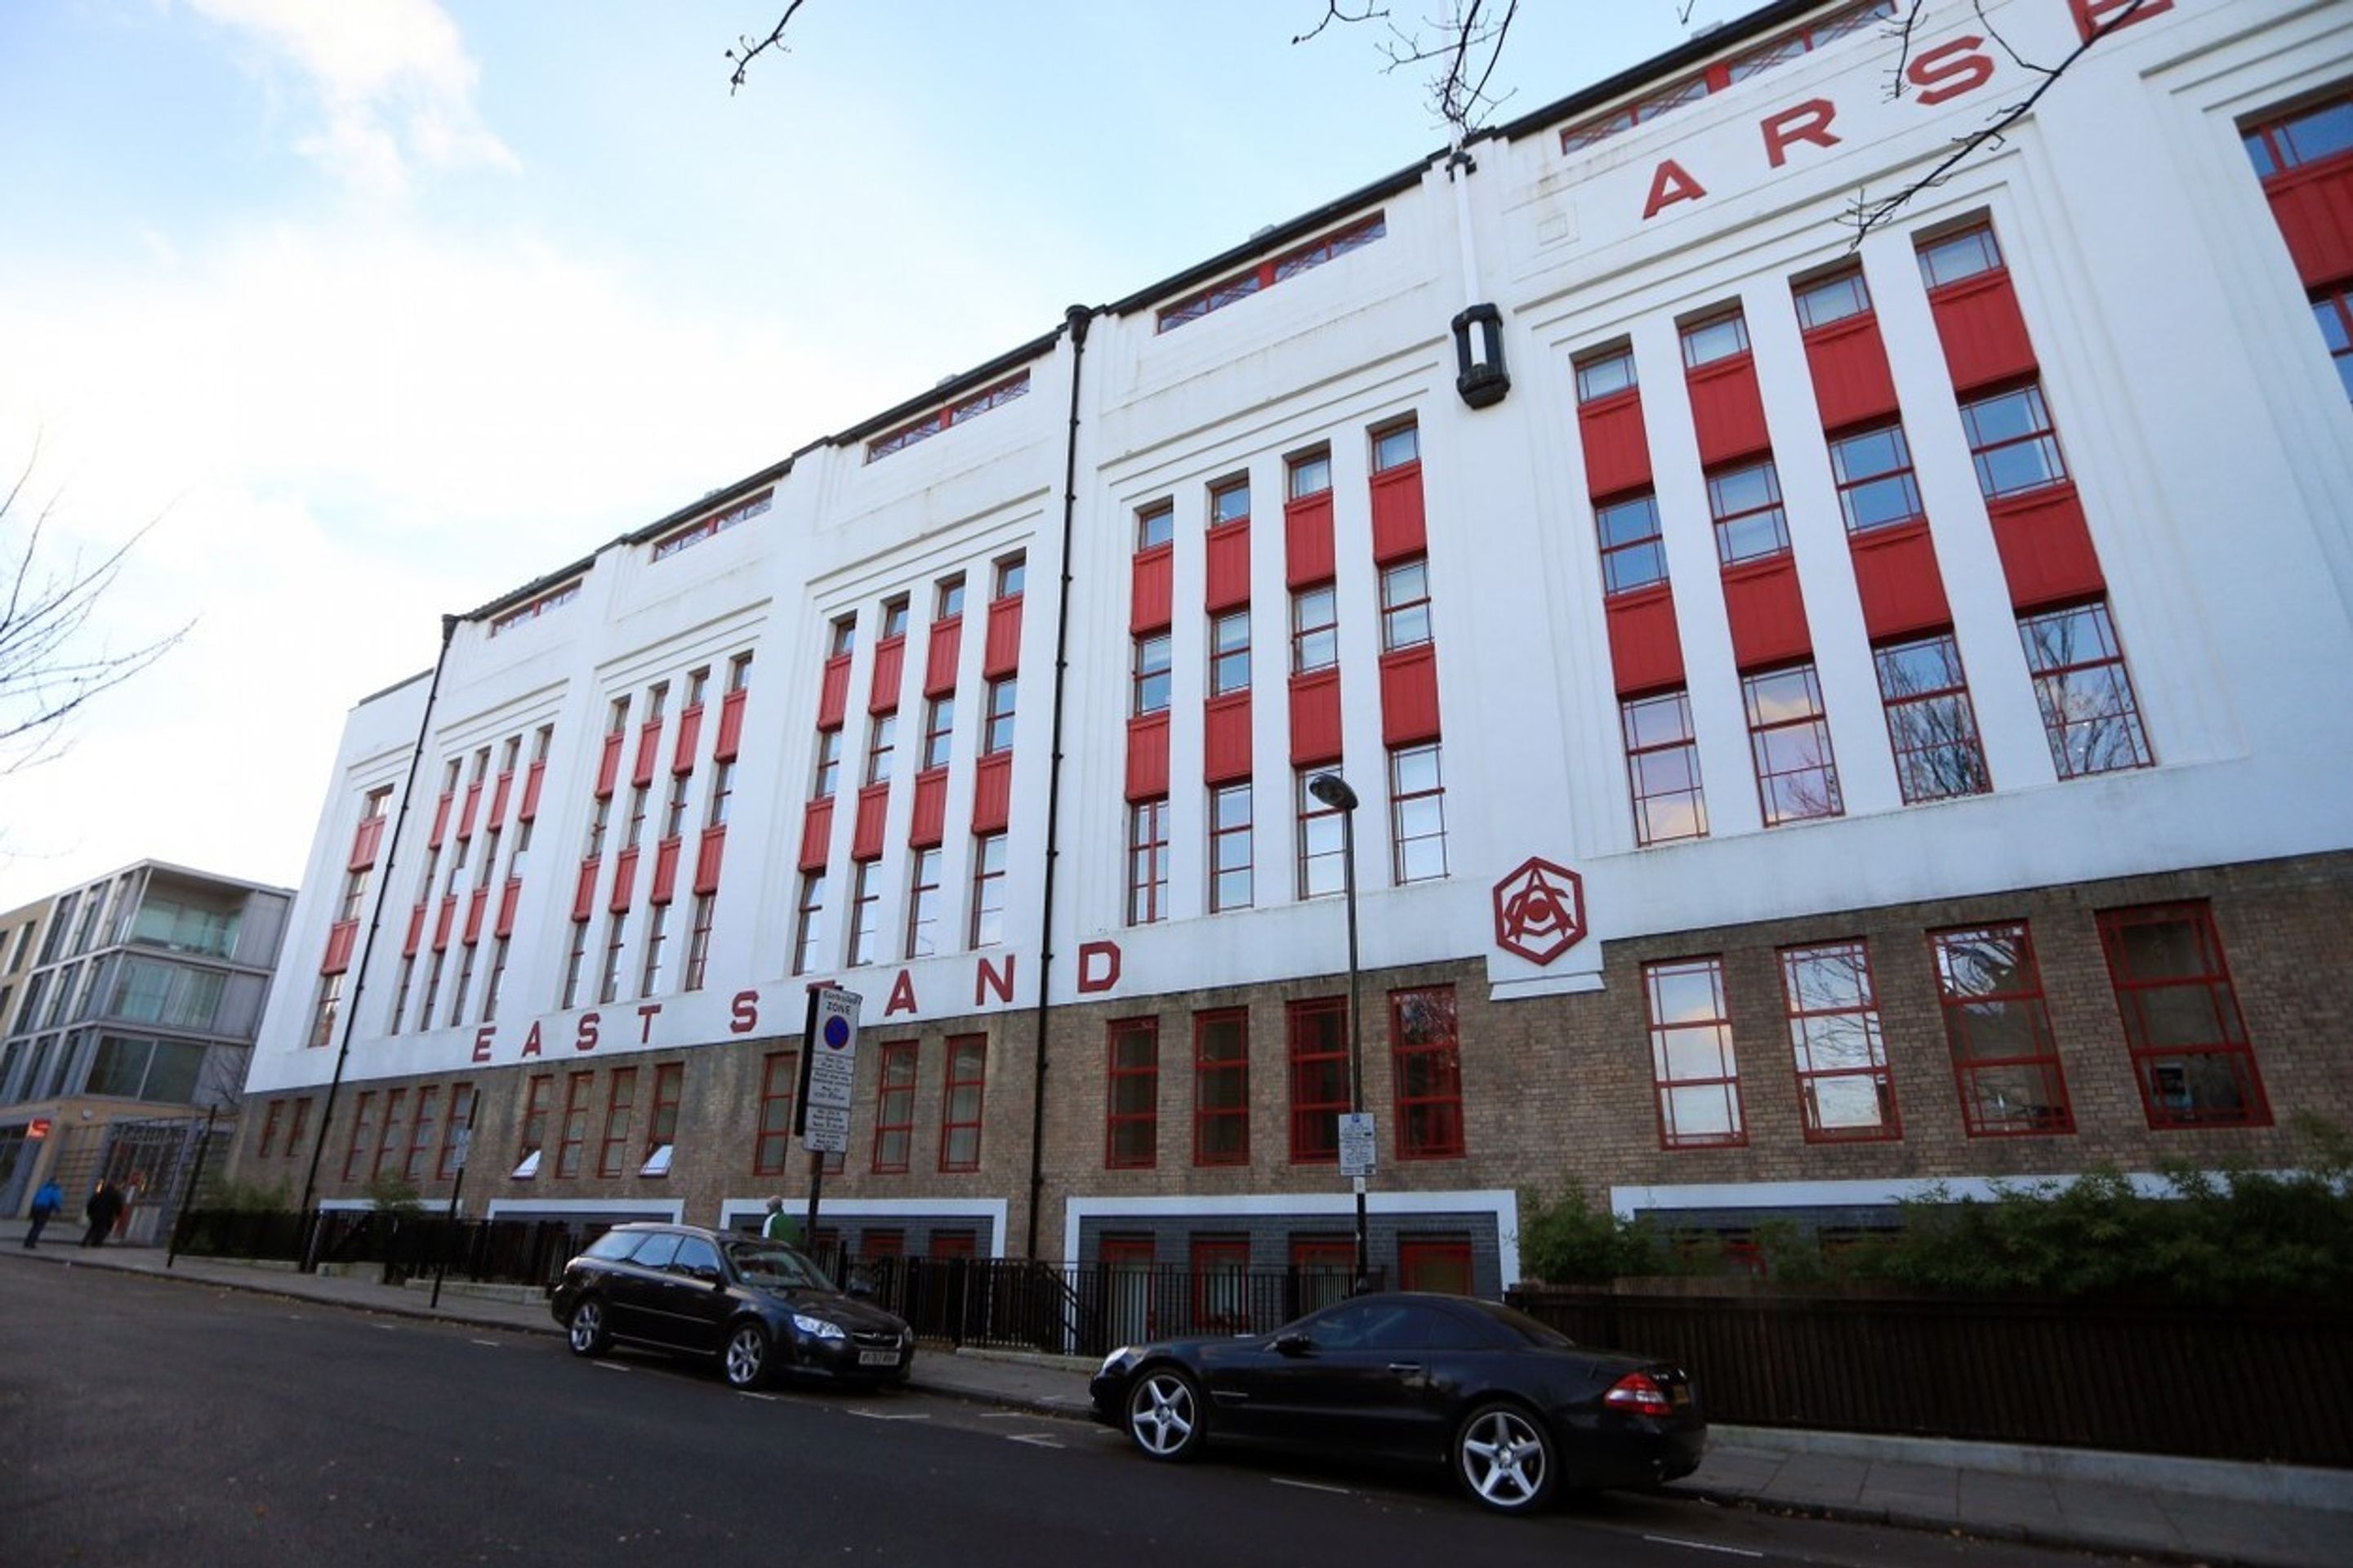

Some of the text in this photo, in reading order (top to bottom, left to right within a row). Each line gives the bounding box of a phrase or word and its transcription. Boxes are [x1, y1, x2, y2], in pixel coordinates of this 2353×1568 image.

[471, 939, 1121, 1062] EAST SAND
[827, 1001, 851, 1016] ZONE
